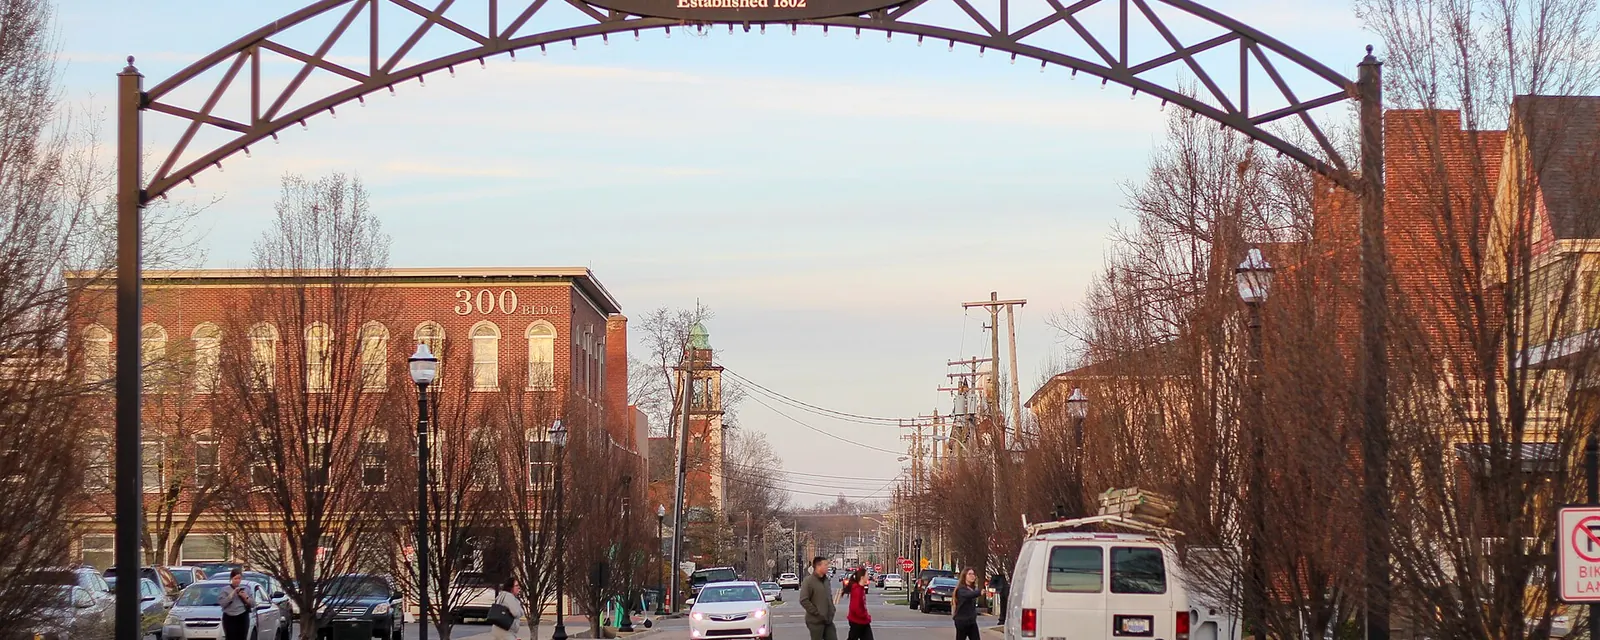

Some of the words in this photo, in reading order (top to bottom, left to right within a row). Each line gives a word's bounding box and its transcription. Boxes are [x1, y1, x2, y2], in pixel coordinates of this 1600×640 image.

[677, 0, 768, 8] Established
[773, 0, 807, 8] 1802
[454, 289, 518, 315] 300
